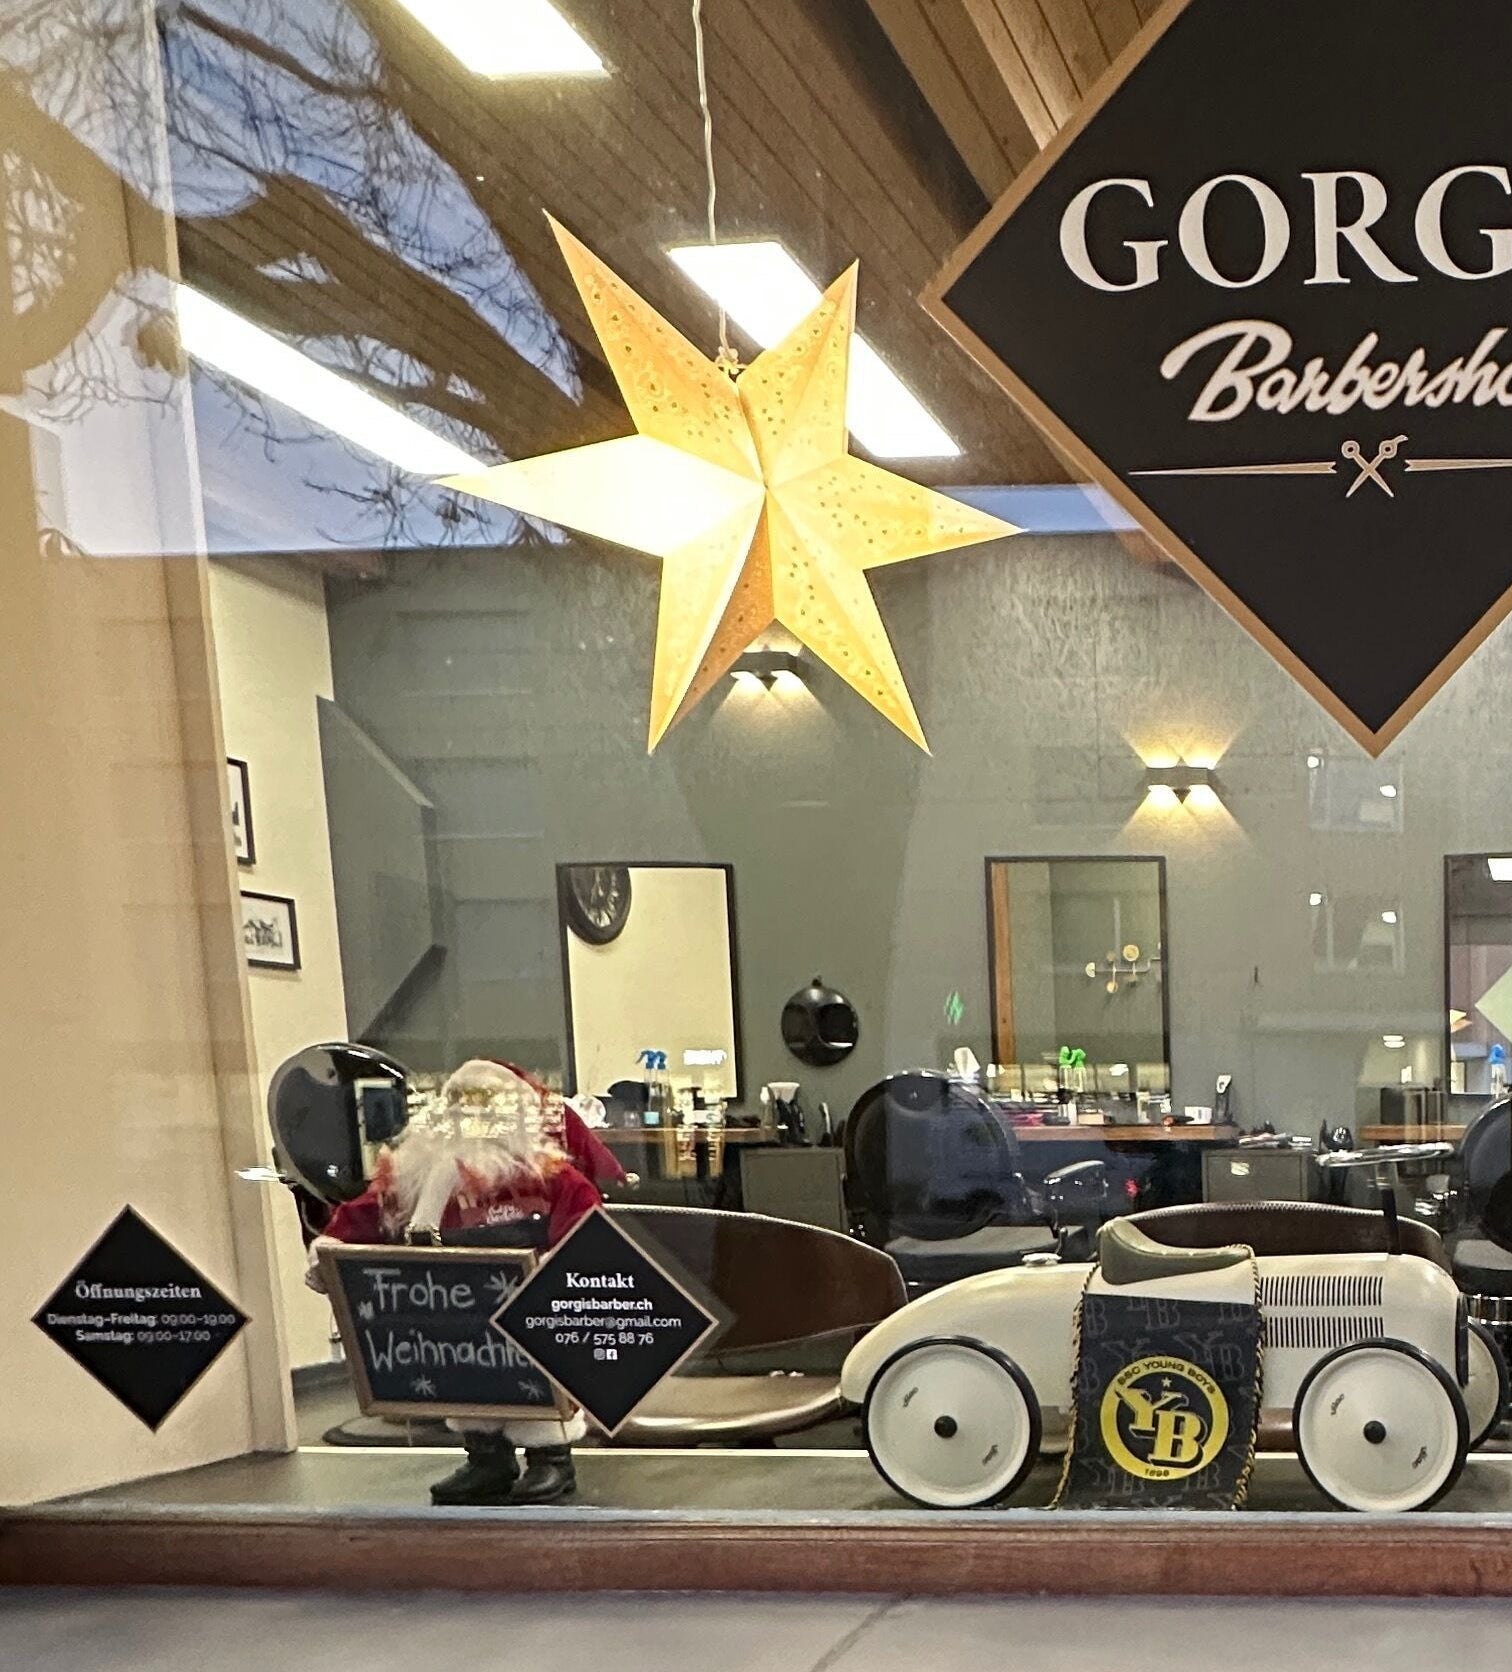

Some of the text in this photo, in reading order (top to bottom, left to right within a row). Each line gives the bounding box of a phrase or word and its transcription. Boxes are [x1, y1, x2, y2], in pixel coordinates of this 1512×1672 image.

[75, 1279, 203, 1302] Öffnungszeiten
[362, 1267, 476, 1311] Frohe
[565, 1272, 635, 1289] Kontakt
[551, 1297, 654, 1313] gorgisbarber.ch
[525, 1314, 682, 1330] gorgisbarber@gmail.com
[555, 1332, 580, 1345] 076
[593, 1334, 616, 1346] 575
[618, 1332, 636, 1345] 88
[638, 1332, 655, 1345] 76
[364, 1328, 534, 1373] Weihnachte
[1143, 1360, 1185, 1373] YOUNG
[1187, 1367, 1216, 1394] BOYS
